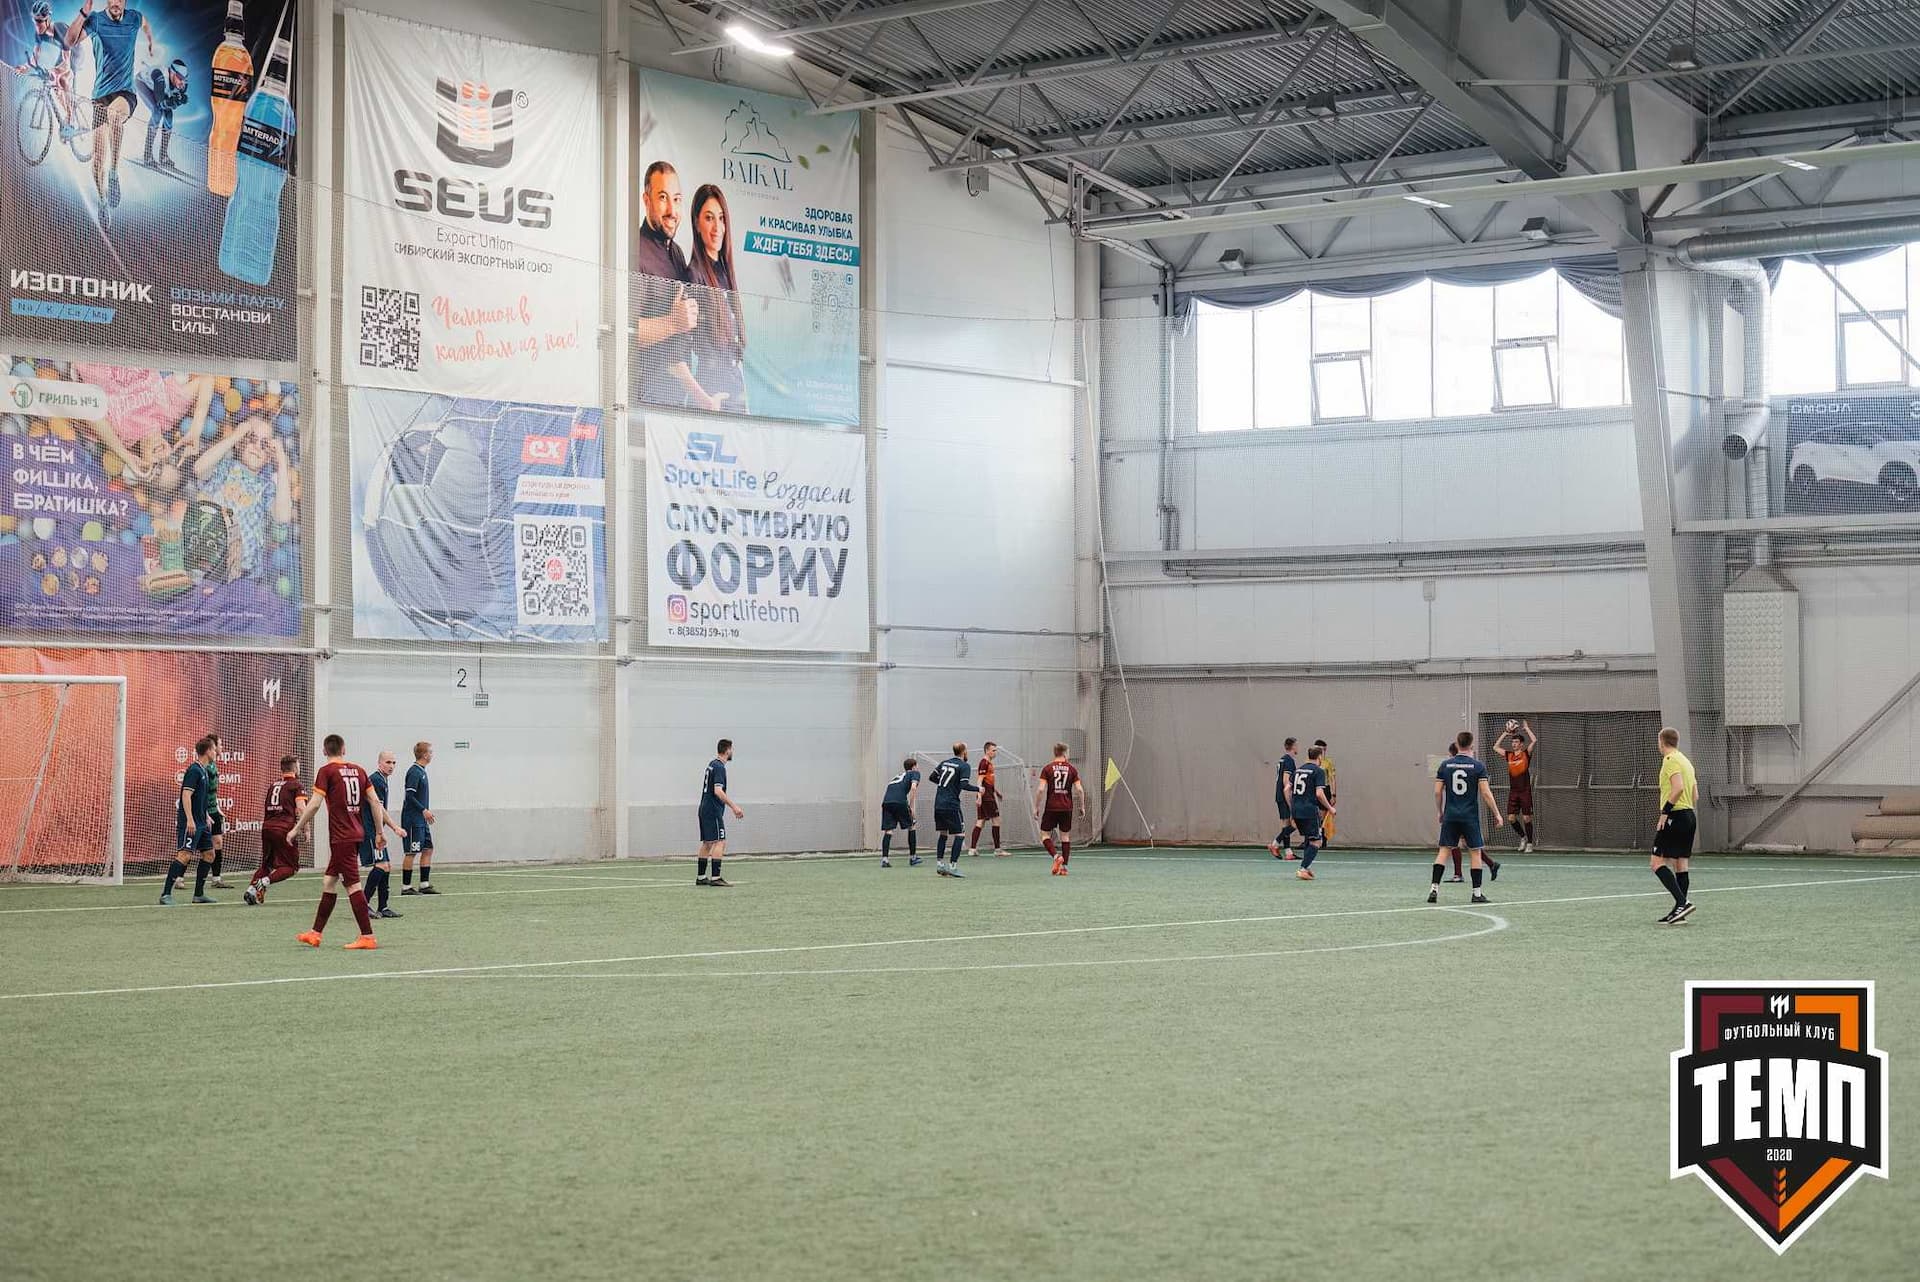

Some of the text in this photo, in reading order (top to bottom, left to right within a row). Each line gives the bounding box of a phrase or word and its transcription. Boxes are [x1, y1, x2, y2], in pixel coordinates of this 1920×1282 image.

[723, 158, 793, 191] BAIKAL
[394, 169, 553, 229] SEUS
[760, 216, 853, 240] И КРАСИВАЯ УЛЫБКА
[805, 207, 853, 224] ЗДОРОВАЯ
[437, 227, 513, 251] Export Union
[752, 235, 853, 263] ЖДЕТ ТЕБЯ ЗДЕСЬ!
[394, 243, 552, 273] СИБИРСКИЙ ЭКСПОРТНЫЙ СОЮЗ
[10, 268, 153, 304] ИЗОТОНИК
[171, 287, 234, 304] ВОЗЬМИ
[171, 303, 270, 324] ВОССТАНОВИ
[431, 296, 517, 329] Чемпион
[172, 319, 218, 335] СИЛЫ.
[519, 337, 537, 361] из
[39, 392, 78, 405] ГРИЛЬ
[13, 438, 74, 464] В ЧЁМ
[685, 432, 737, 464] SL
[13, 468, 98, 493] ФИШКА,
[664, 463, 757, 490] SportLife
[763, 471, 855, 510] Создаем
[13, 492, 129, 516] БРАТИШКА?
[666, 503, 850, 541] СПОРТИВНУЮ
[667, 539, 848, 598] ФОРМУ
[690, 599, 800, 625] sportlifebrn
[457, 668, 467, 688] 2
[939, 766, 956, 788] 77
[1053, 770, 1069, 790] 27
[1293, 772, 1307, 795] 15
[1452, 769, 1468, 795] 6
[270, 785, 282, 806] 8
[343, 776, 360, 806] 19
[185, 838, 193, 848] 2
